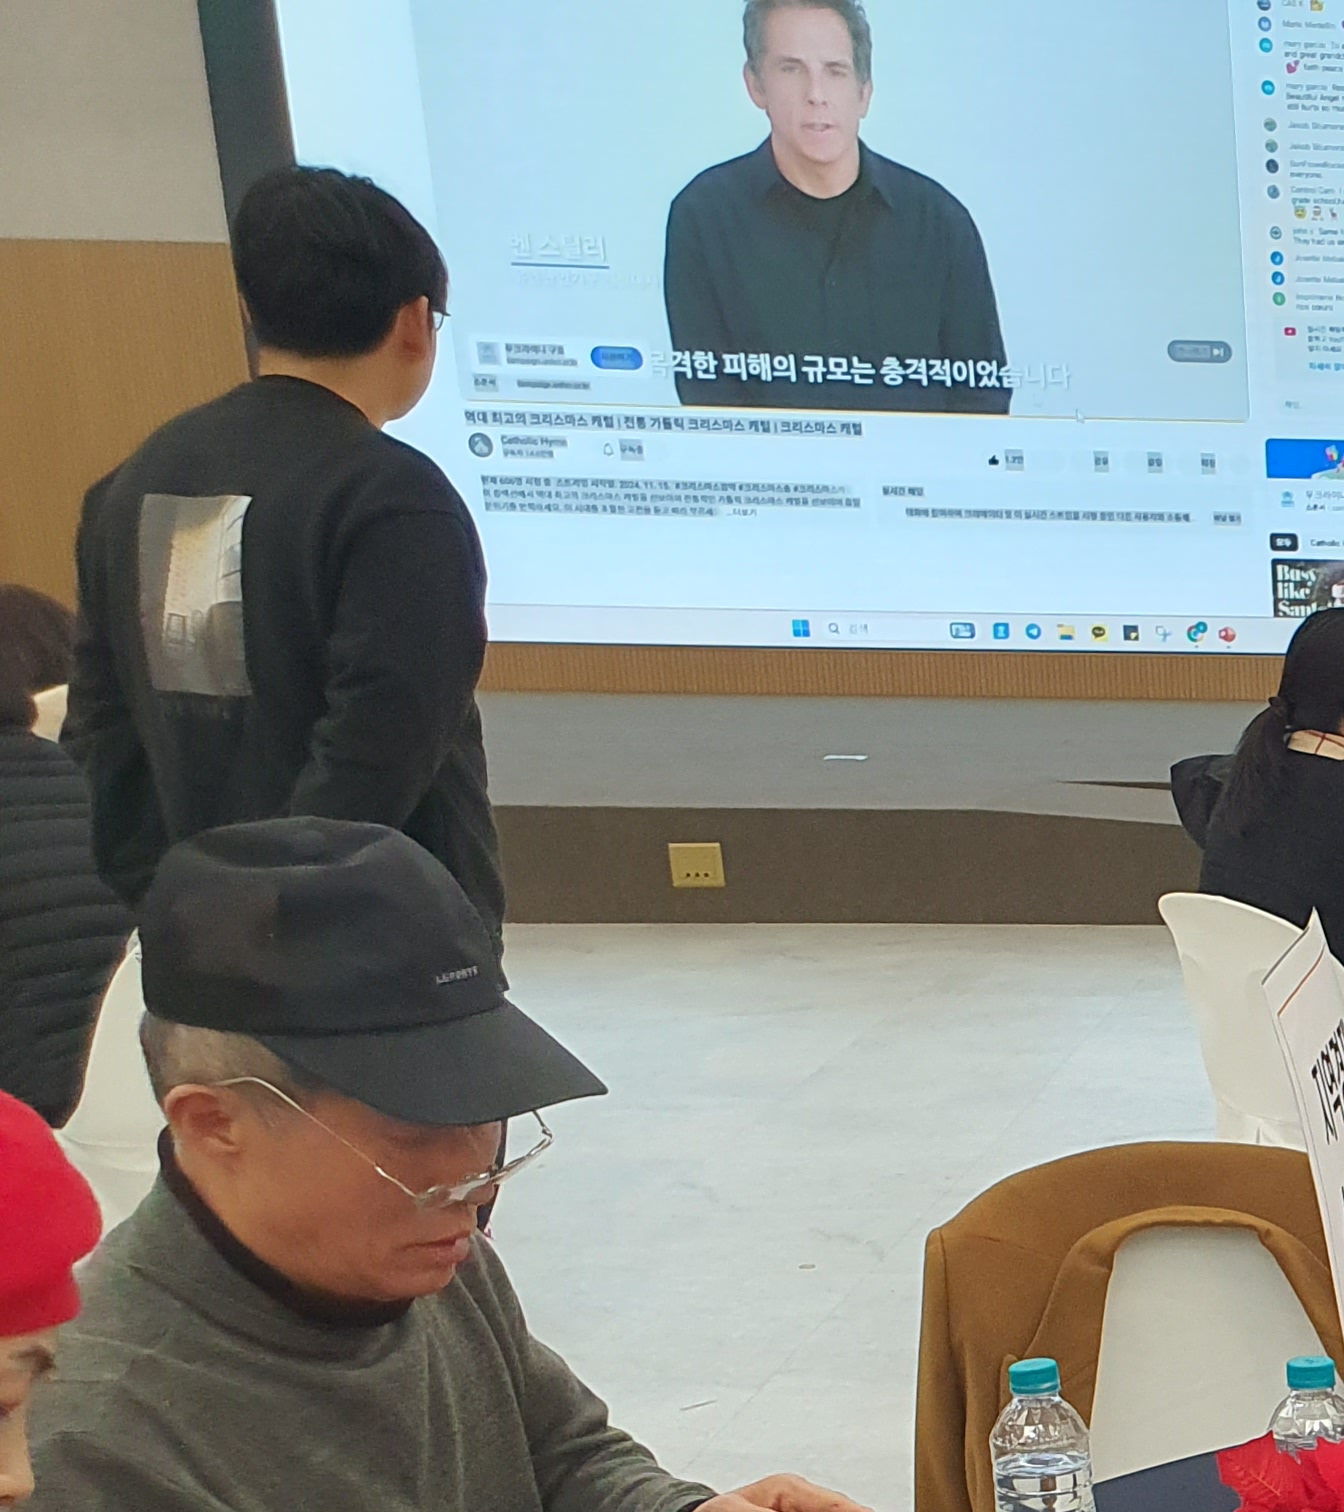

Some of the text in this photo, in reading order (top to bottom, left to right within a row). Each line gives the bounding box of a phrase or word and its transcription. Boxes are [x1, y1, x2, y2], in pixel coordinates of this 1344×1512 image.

[723, 352, 797, 383] 피해의
[801, 355, 876, 386] 규모는
[880, 357, 1070, 390] 충격적이었습니다
[464, 411, 488, 424] 역대
[492, 412, 526, 425] 최고의
[530, 413, 588, 427] 크리스마스
[688, 418, 745, 432] 크리스마스
[780, 421, 837, 434] 크리스마스
[1276, 564, 1317, 582] Busy
[1277, 581, 1311, 599] like
